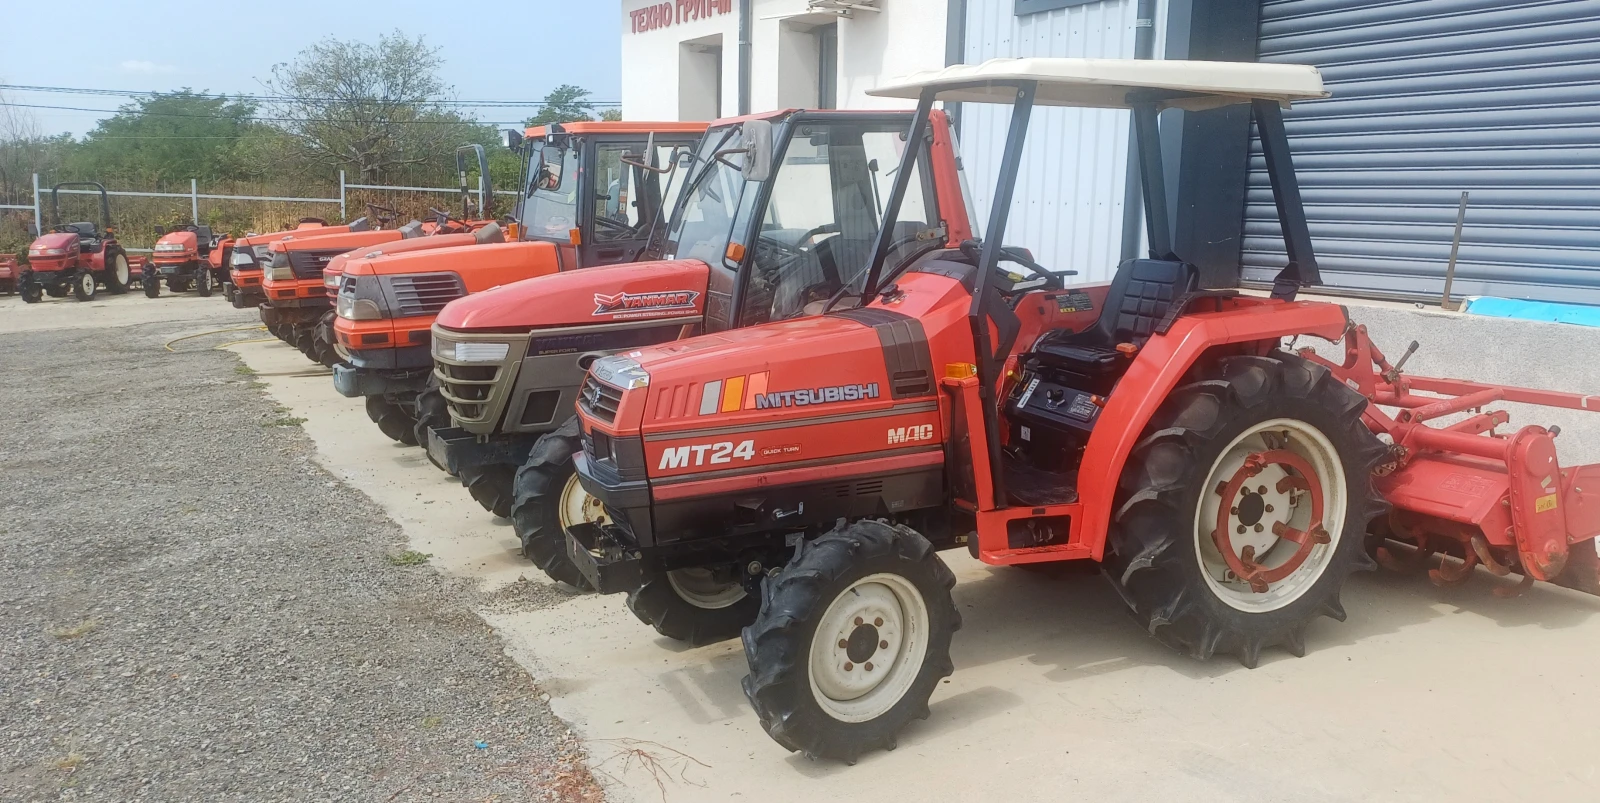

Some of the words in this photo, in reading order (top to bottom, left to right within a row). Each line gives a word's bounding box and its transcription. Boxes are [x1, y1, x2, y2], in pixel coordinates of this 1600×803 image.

[630, 2, 672, 34] ТЕХНО
[623, 292, 689, 308] YANMAR
[755, 383, 879, 409] MITSUBISHI
[888, 424, 933, 444] MAC
[658, 440, 755, 469] MT24
